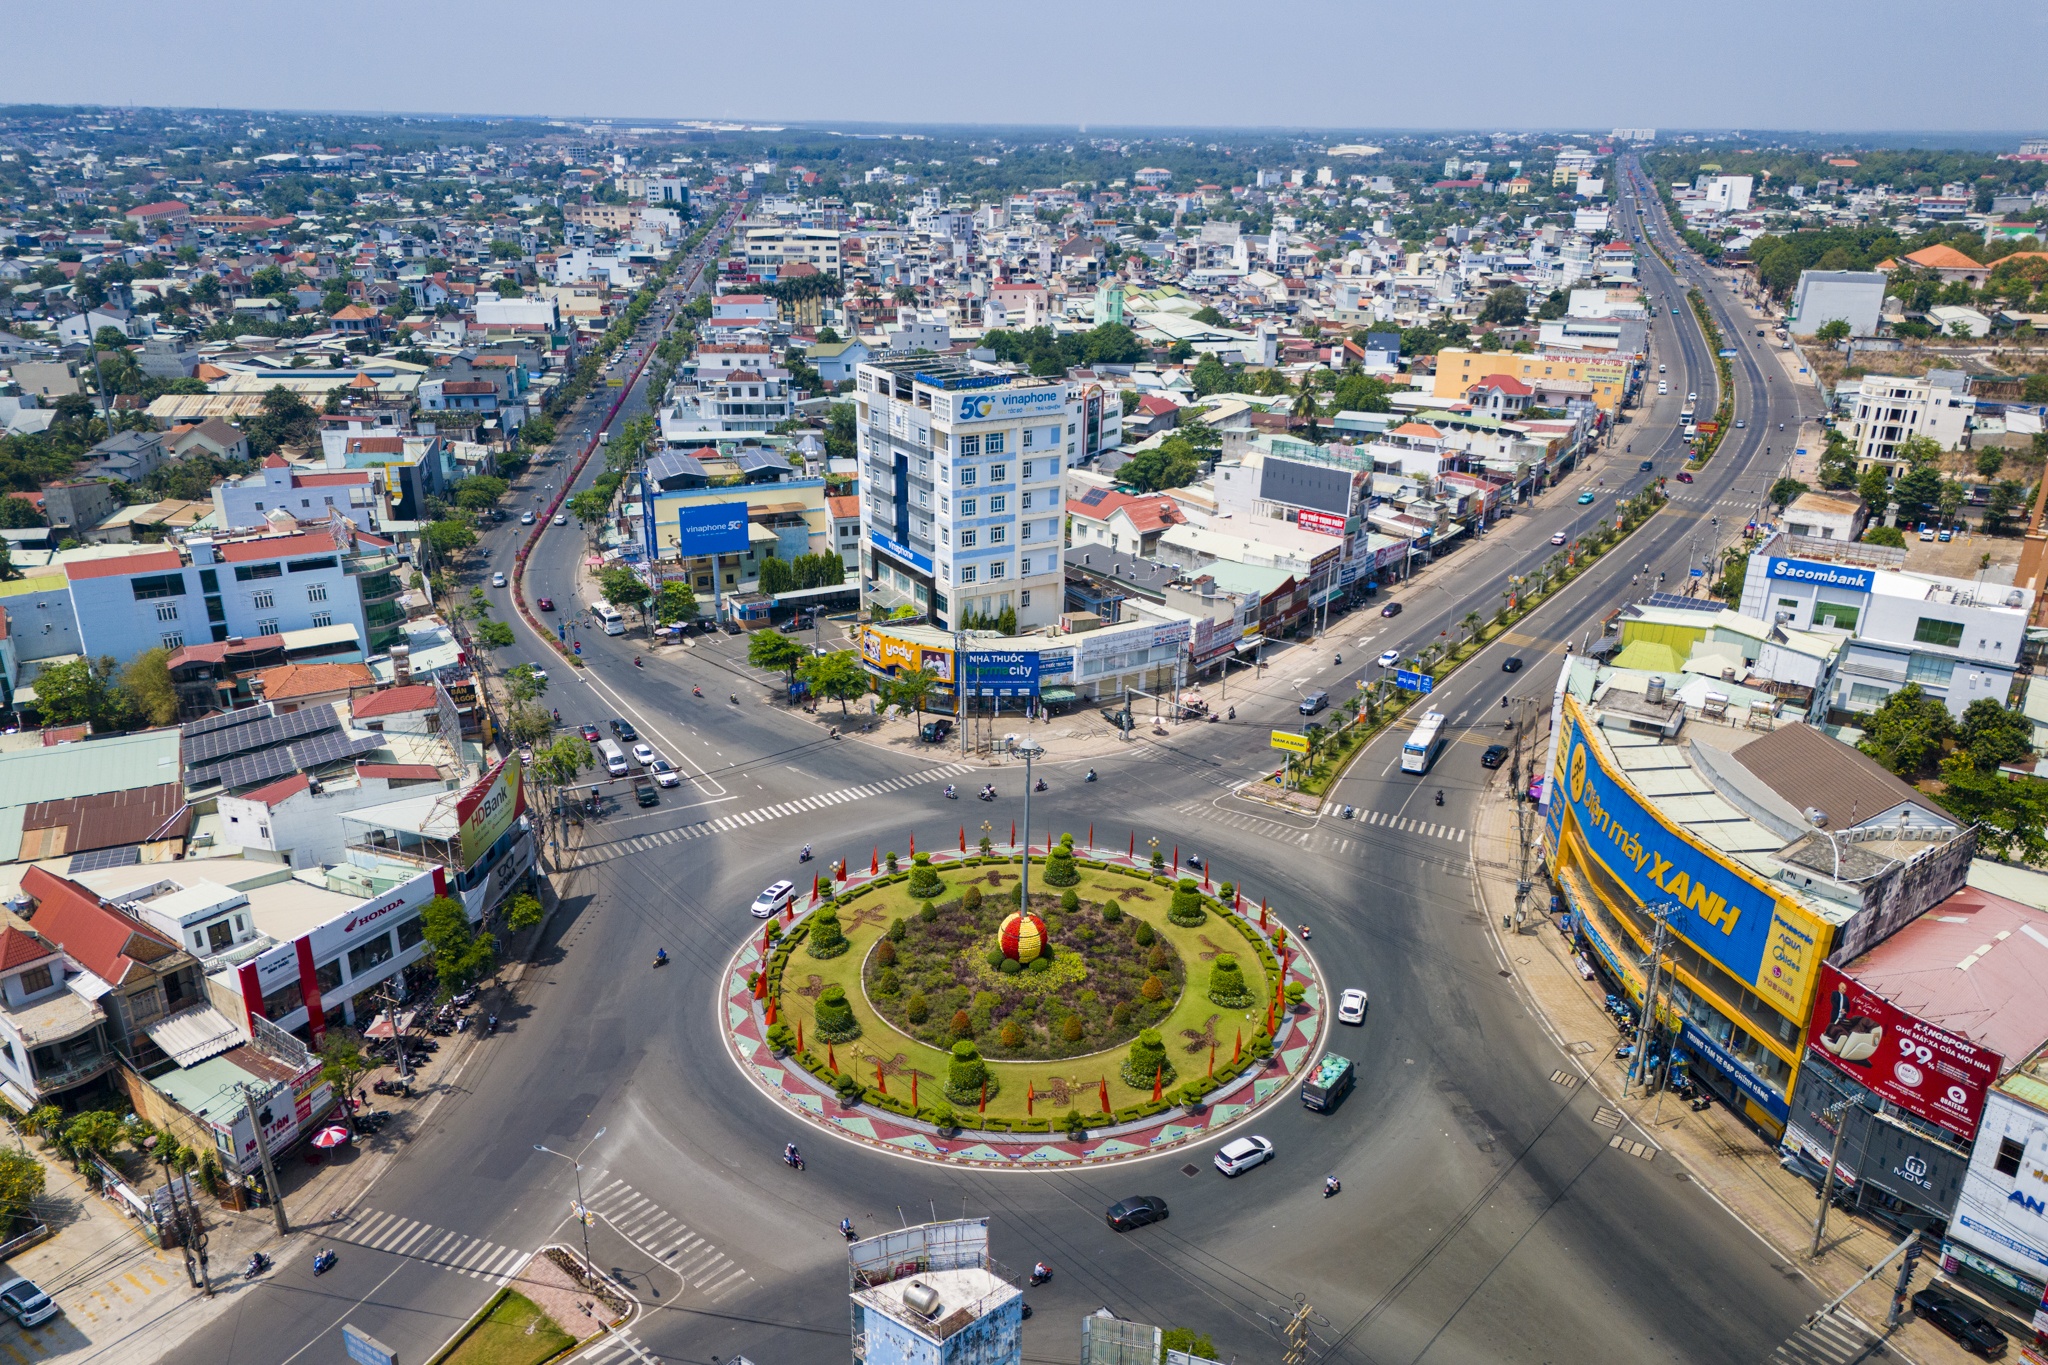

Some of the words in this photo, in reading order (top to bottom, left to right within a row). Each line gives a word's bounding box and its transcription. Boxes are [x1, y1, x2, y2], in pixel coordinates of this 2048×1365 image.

[1002, 391, 1057, 406] vinaphone
[686, 523, 727, 534] vinaphone
[888, 541, 914, 560] vinaphone
[1774, 561, 1866, 587] Sacombank
[886, 643, 914, 662] yody
[970, 653, 990, 663] NHÀ
[991, 652, 1024, 663] THUỐC
[471, 786, 508, 831] HDBank
[1583, 779, 1610, 833] Điện
[1608, 820, 1651, 873] máy
[1647, 851, 1742, 937] XANH
[499, 867, 517, 890] SOMA
[358, 898, 405, 927] HONDA
[1774, 914, 1813, 946] Panasonic
[1779, 933, 1802, 954] AQUA
[1773, 945, 1800, 972] Midea
[1763, 976, 1795, 1004] TOSHIBA
[1781, 973, 1793, 986] LG
[1895, 1024, 1912, 1036] GHẾ
[1912, 1032, 1938, 1050] MÁT-XA
[1940, 1045, 1956, 1057] CỦA
[1957, 1052, 1973, 1065] MỌI
[1974, 1060, 1991, 1073] NHÀ
[1687, 1030, 1704, 1049] TRUNG
[1704, 1044, 1716, 1060] TÂM
[1716, 1055, 1723, 1065] XE
[1723, 1060, 1735, 1073] ĐẠP
[1735, 1070, 1753, 1088] CHÍNH
[1753, 1084, 1769, 1102] HÃNG
[245, 1128, 269, 1153] NHT
[271, 1114, 289, 1134] TÂN
[1893, 1166, 1932, 1190] MOVE
[2008, 1190, 2045, 1214] AN
